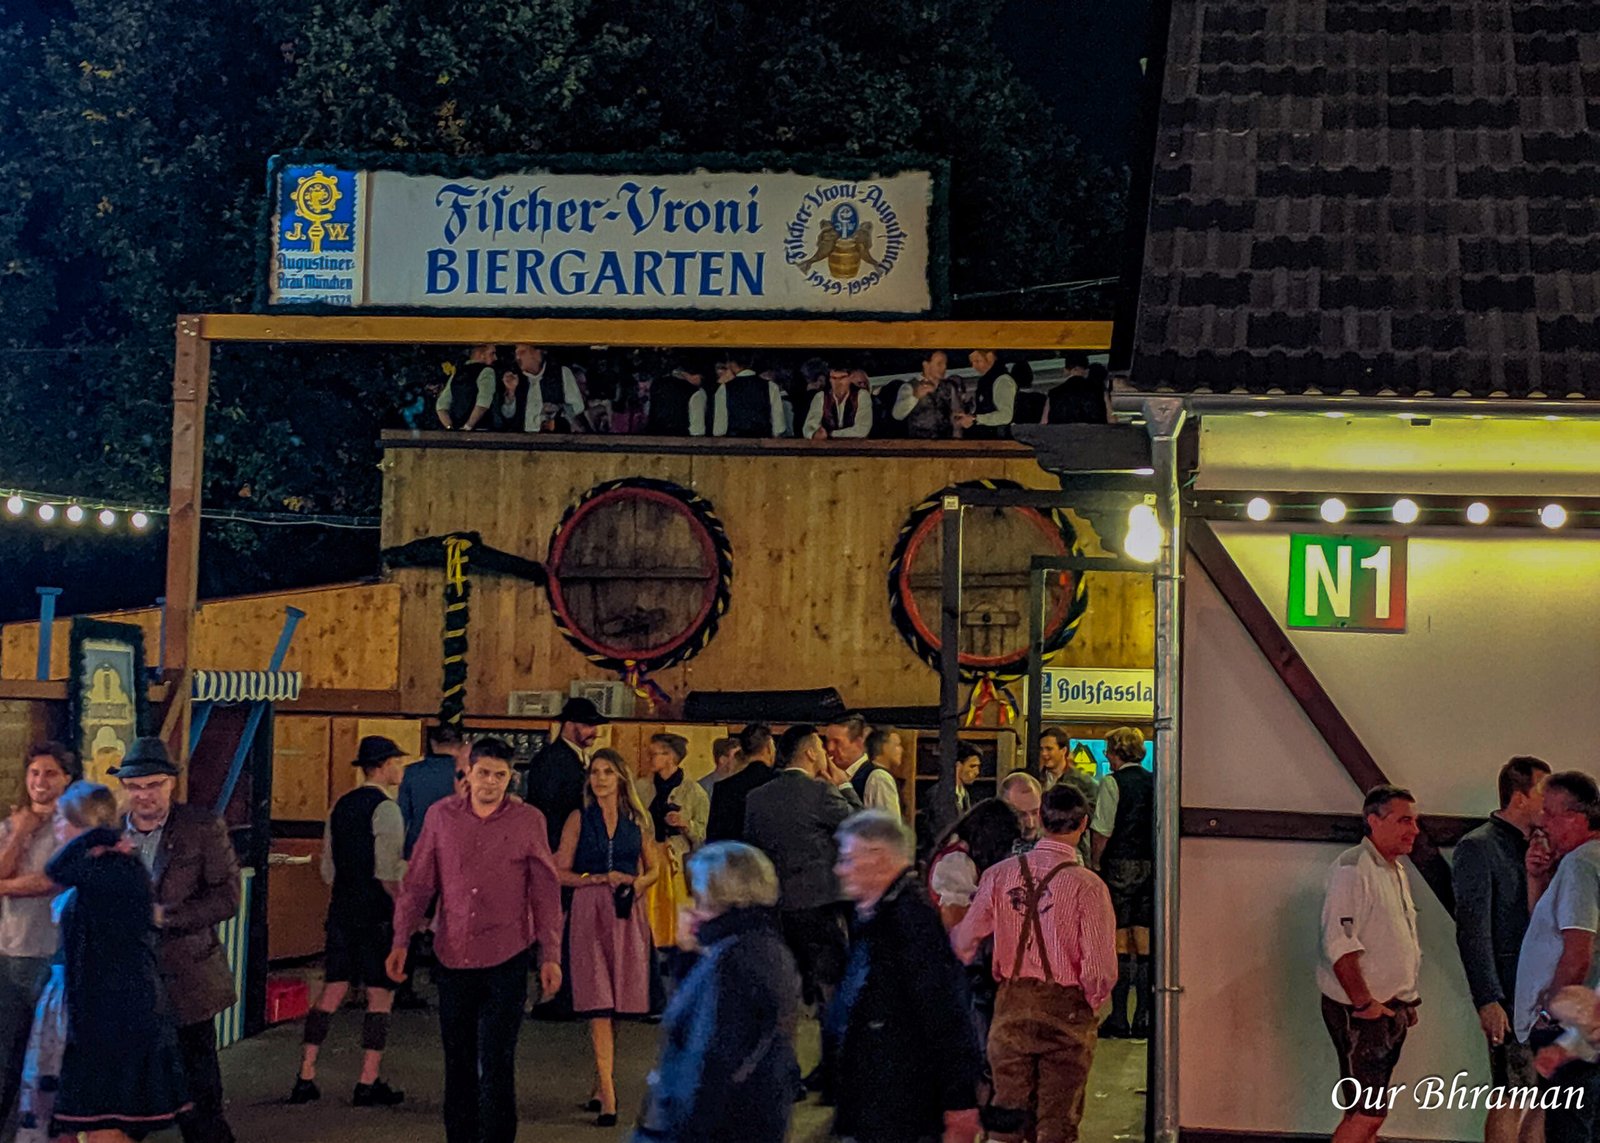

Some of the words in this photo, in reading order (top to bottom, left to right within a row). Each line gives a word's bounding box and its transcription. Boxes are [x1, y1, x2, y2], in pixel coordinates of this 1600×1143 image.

[435, 181, 764, 245] Fischer-Vroni
[425, 248, 766, 296] BIERGARTEN
[805, 270, 882, 296] 1949-1999
[1304, 544, 1391, 620] N1
